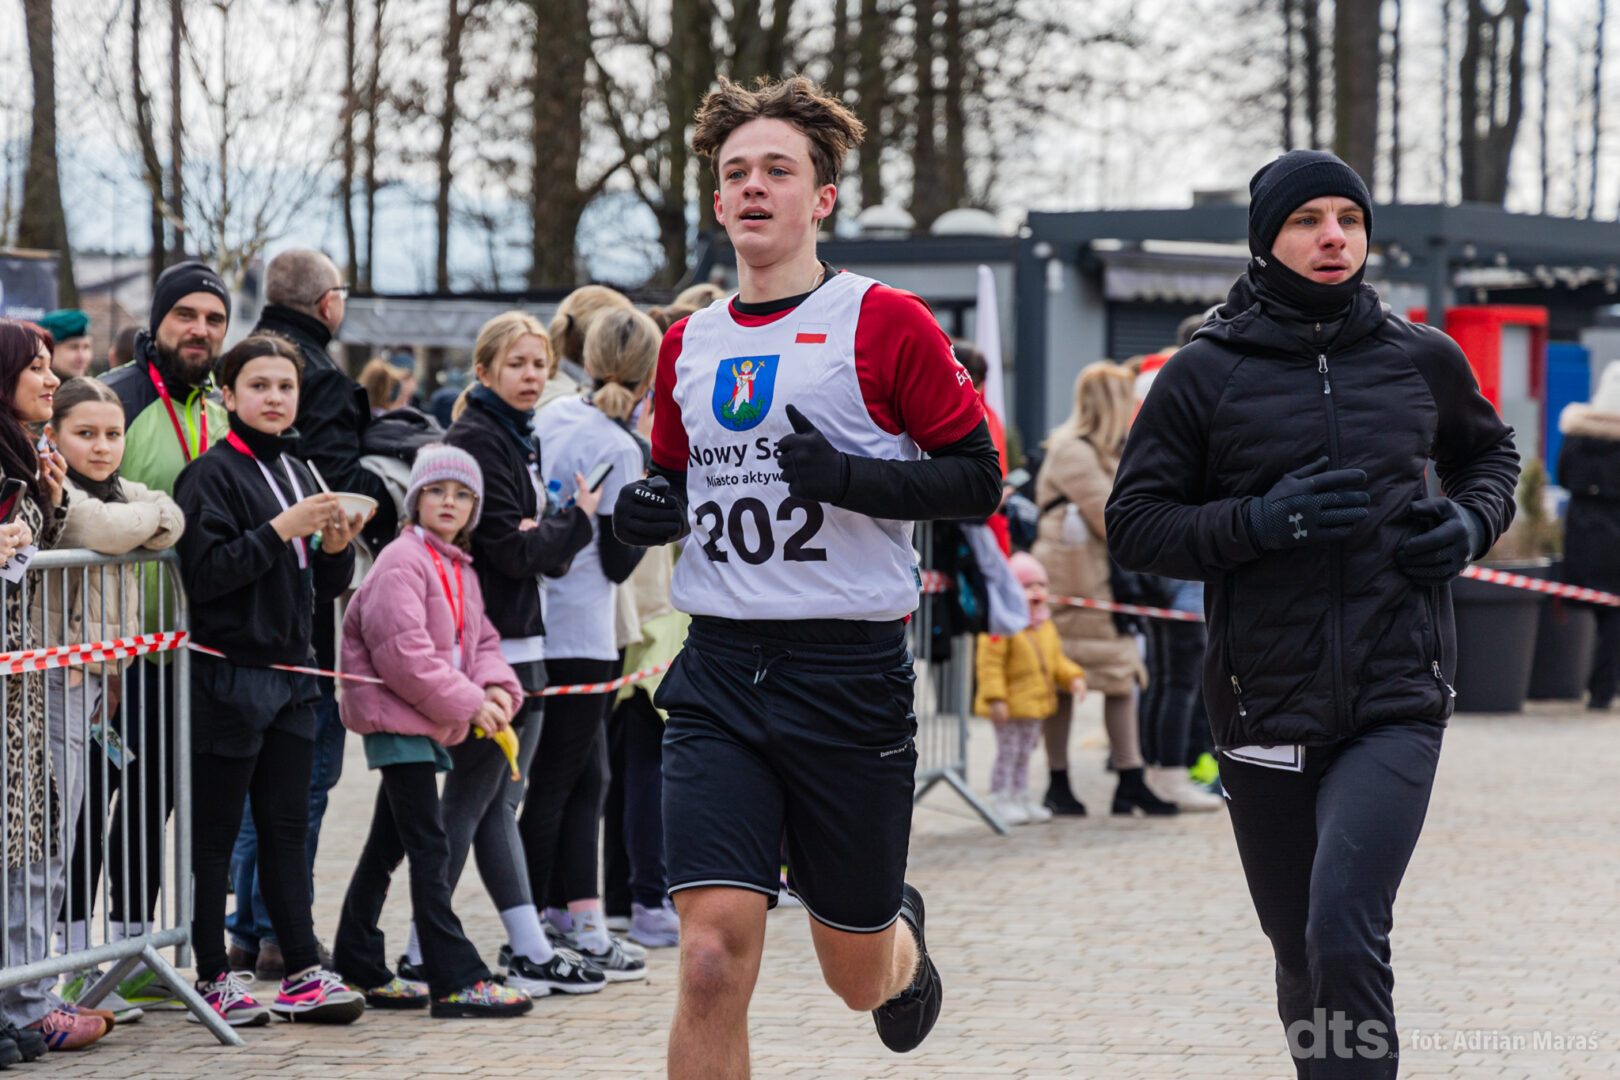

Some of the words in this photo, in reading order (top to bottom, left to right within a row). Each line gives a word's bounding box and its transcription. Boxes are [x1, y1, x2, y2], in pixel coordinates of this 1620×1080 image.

[689, 444, 748, 467] Nowy
[706, 474, 739, 488] Miasto
[634, 488, 665, 503] KIPSTA
[695, 497, 827, 565] 202
